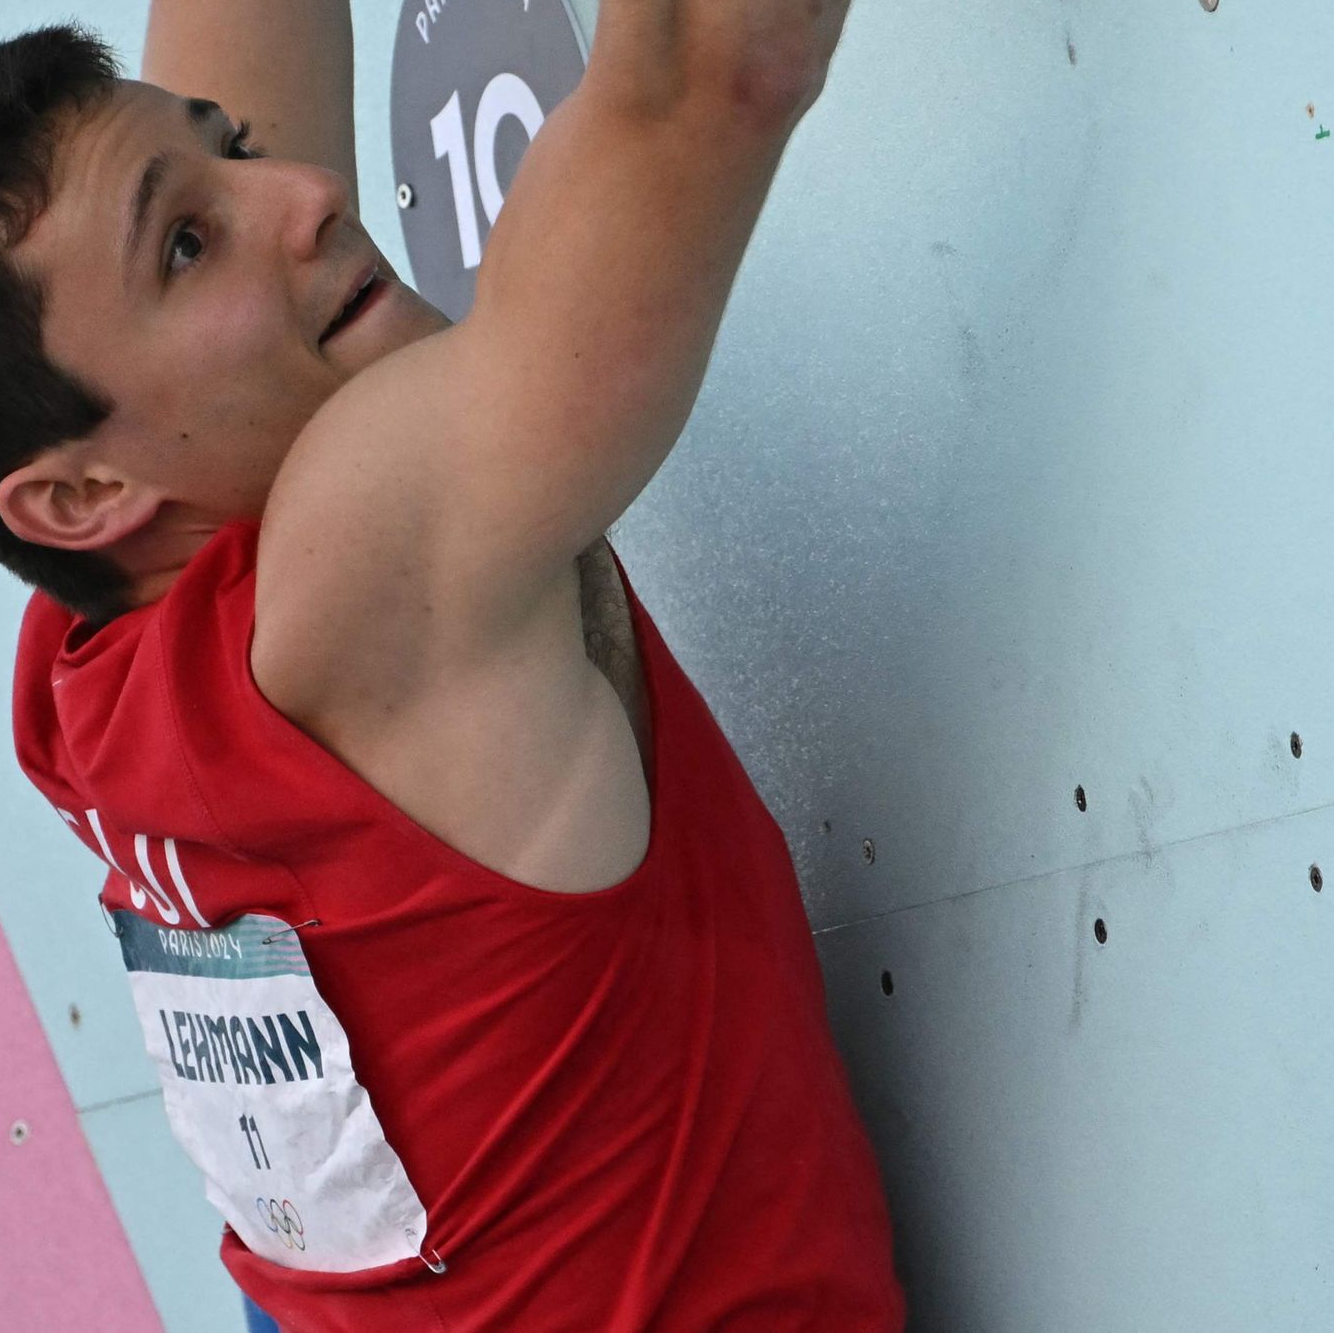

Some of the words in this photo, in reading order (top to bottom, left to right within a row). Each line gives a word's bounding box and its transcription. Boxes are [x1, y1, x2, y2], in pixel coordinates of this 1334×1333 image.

[430, 72, 546, 269] 10
[158, 929, 202, 958] PARIS
[202, 932, 243, 960] 2024
[159, 1009, 324, 1085] LEHMANN
[238, 1113, 271, 1170] 11
